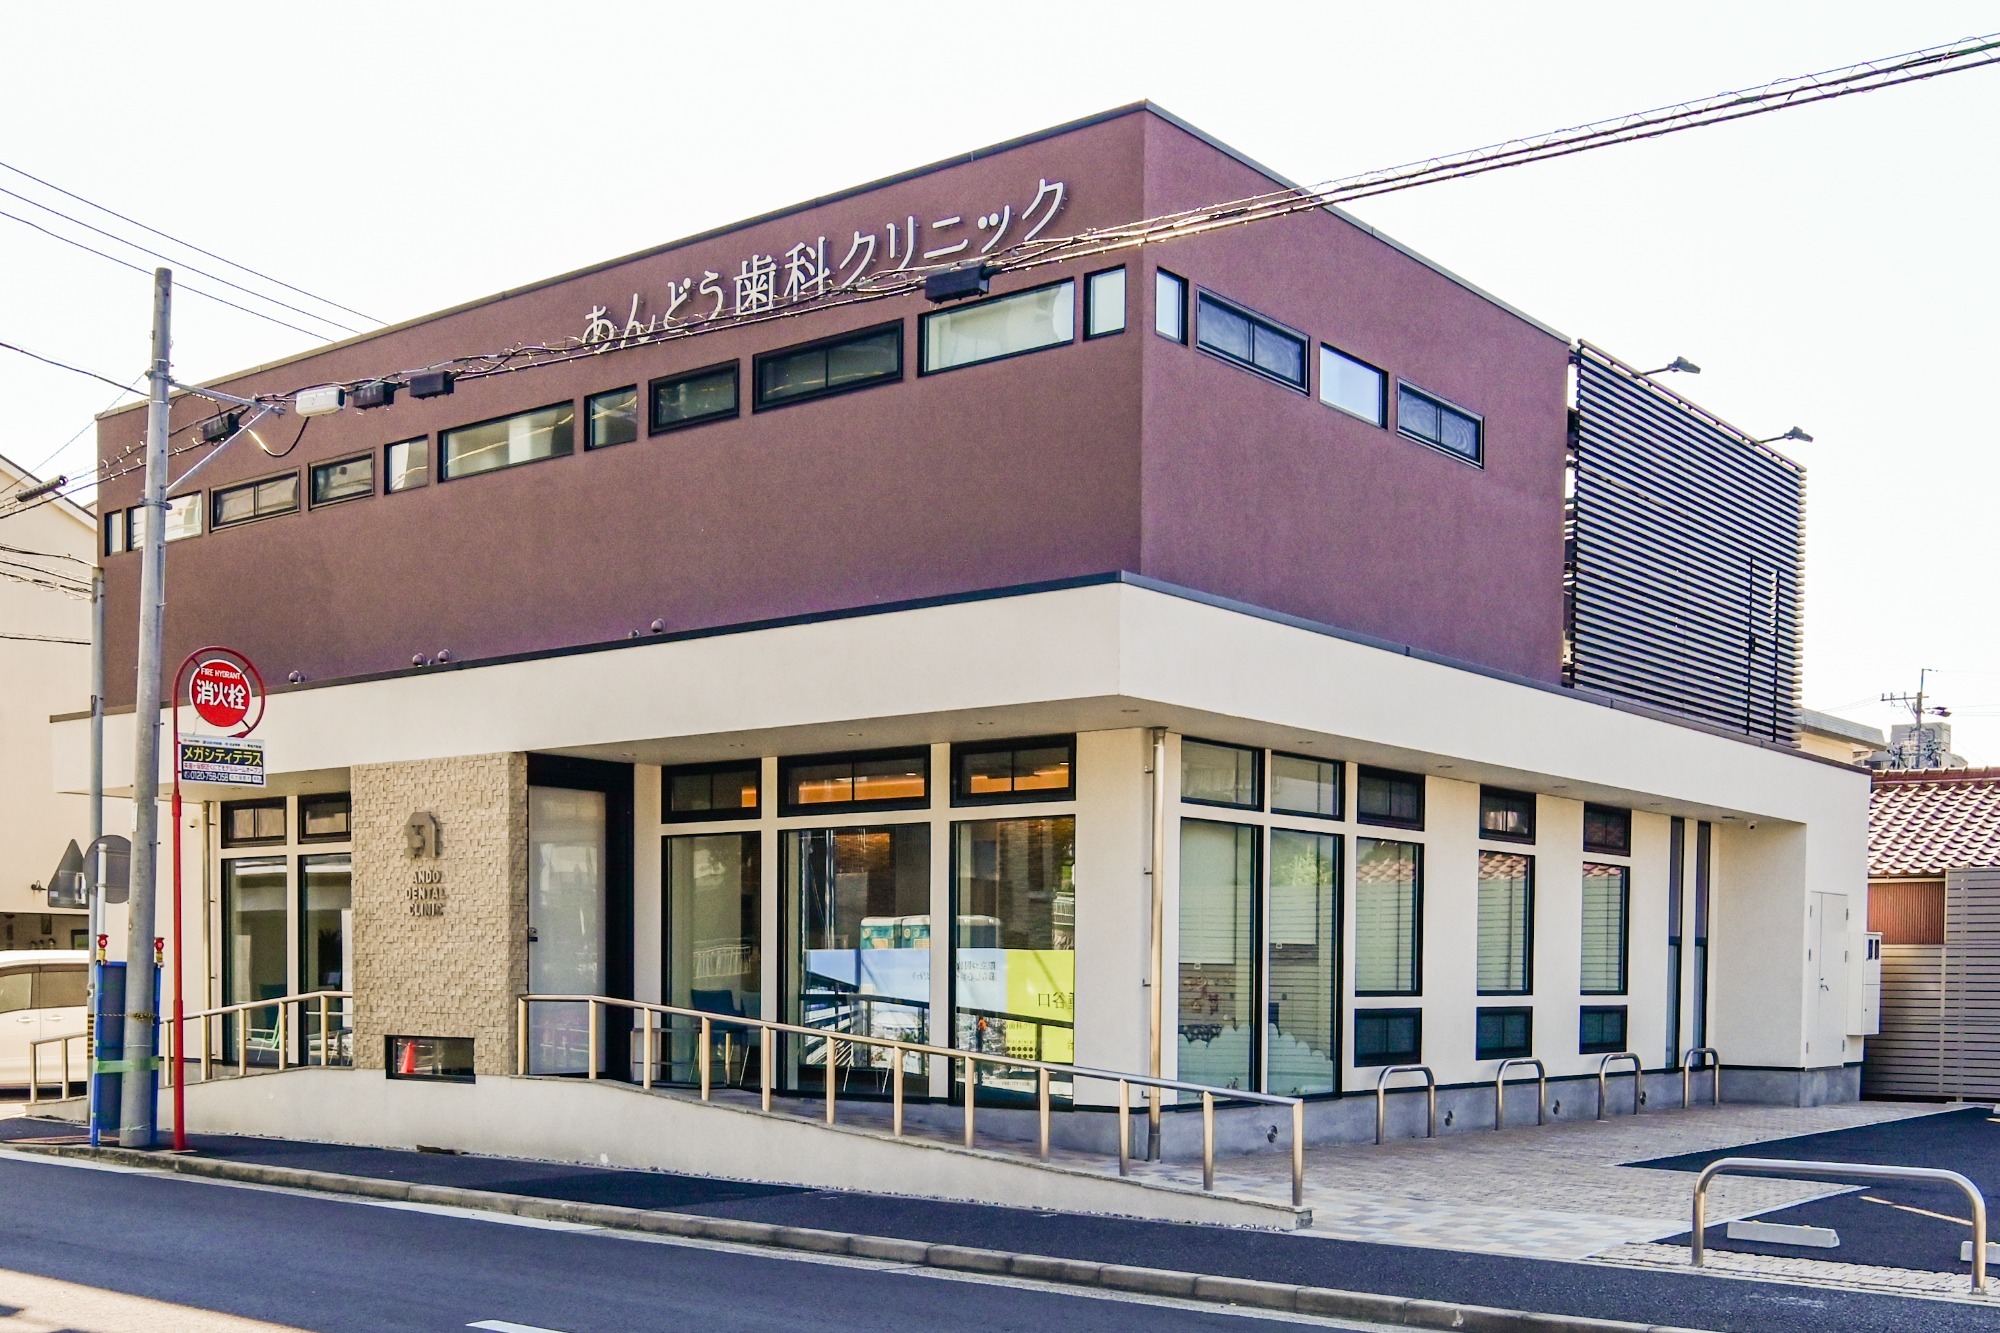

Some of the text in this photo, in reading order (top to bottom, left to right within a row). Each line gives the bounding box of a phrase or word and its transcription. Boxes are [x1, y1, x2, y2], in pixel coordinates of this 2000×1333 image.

[582, 178, 1065, 355] あんどう歯科クリニック
[200, 667, 241, 680] FIRE HYDRANT
[196, 679, 247, 710] 消火栓
[183, 747, 263, 766] メガシティテラス
[413, 871, 442, 884] ANDO
[405, 887, 446, 900] DENTAL
[409, 903, 444, 916] CLINIC
